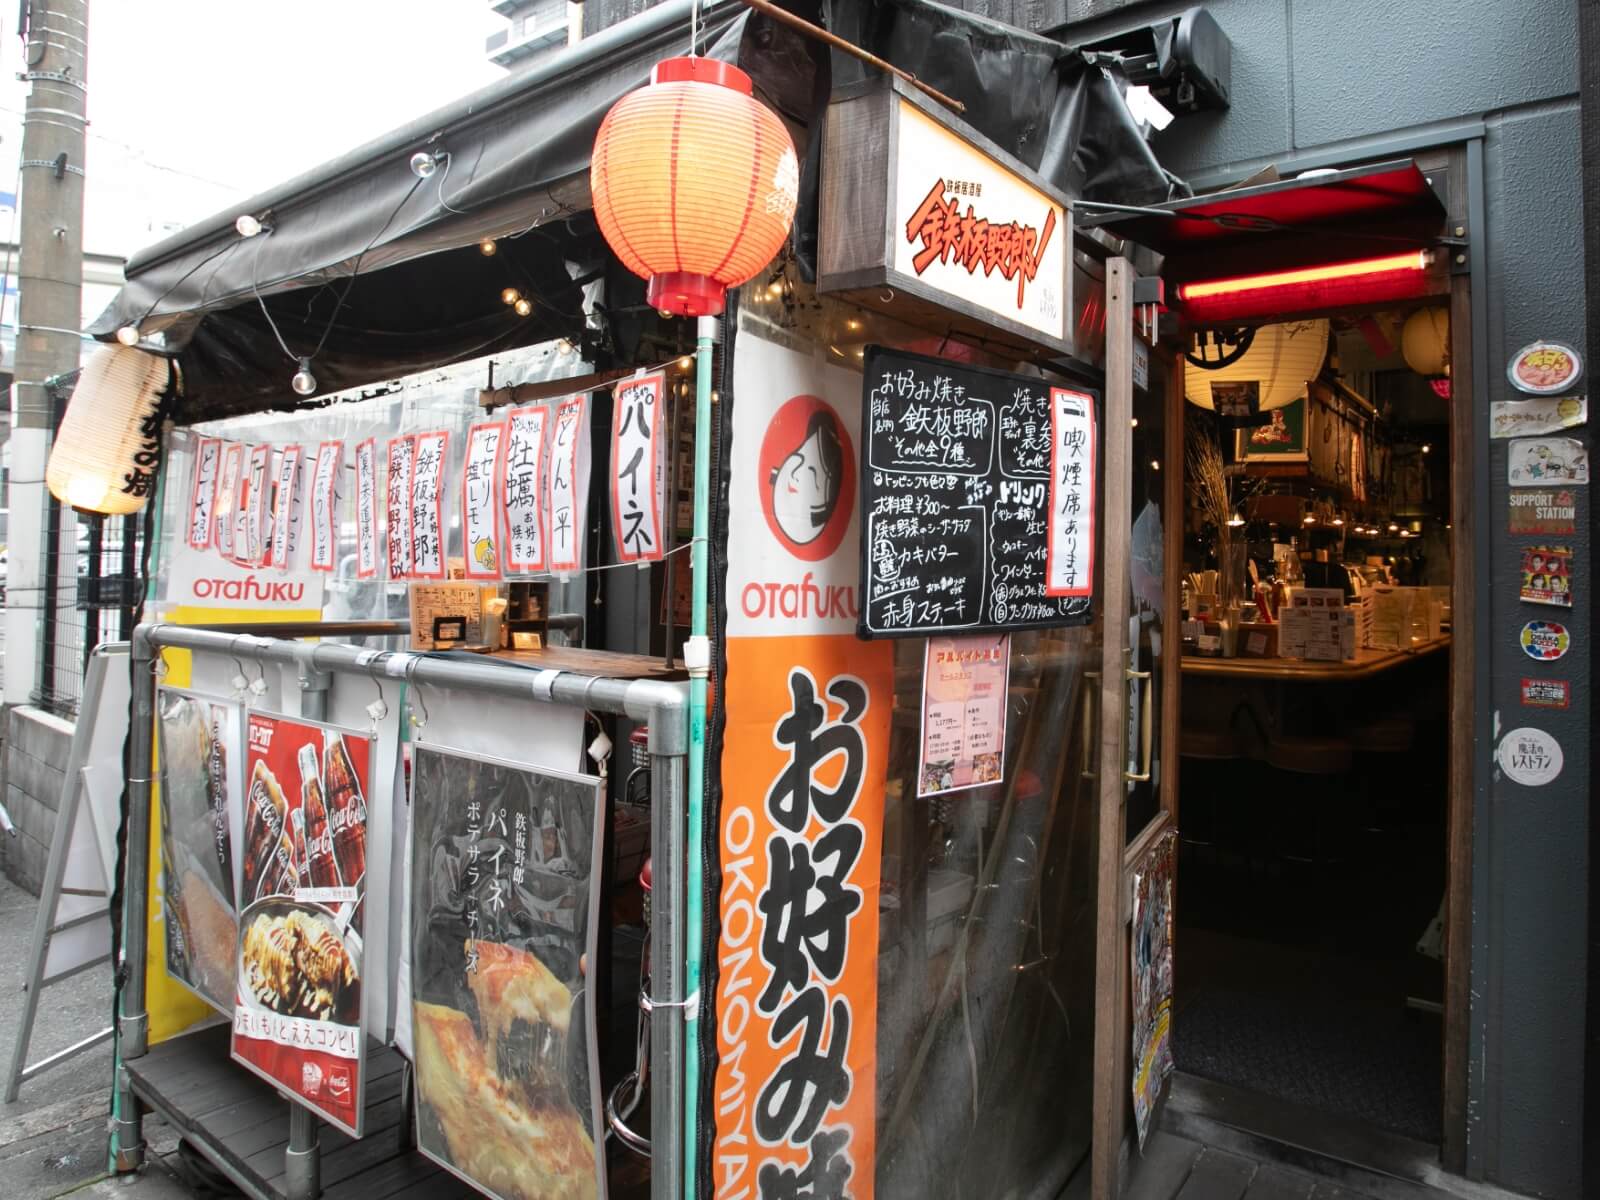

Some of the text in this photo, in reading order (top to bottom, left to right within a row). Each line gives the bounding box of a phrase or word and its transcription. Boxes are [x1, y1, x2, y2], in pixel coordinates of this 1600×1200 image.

[880, 369, 967, 406] お好み焼き
[1010, 387, 1051, 417] 焼き
[898, 403, 988, 440] 鉄板野郎
[480, 433, 498, 508] セセリ
[505, 434, 536, 510] 牡蠣
[619, 393, 655, 559] パイネ
[413, 448, 433, 567] 鉄板野郎
[466, 460, 481, 545] 塩レモン
[999, 481, 1046, 509] ドリンク
[1062, 426, 1087, 589] 喫煙席あります
[1509, 494, 1554, 507] SUPPORT
[1535, 506, 1576, 520] STATION
[898, 544, 959, 568] カキバター
[881, 595, 967, 628] 赤身ステーキ
[1512, 754, 1553, 769] レストラン
[487, 808, 508, 912] パイネ
[512, 812, 527, 885] 鉄板野郎
